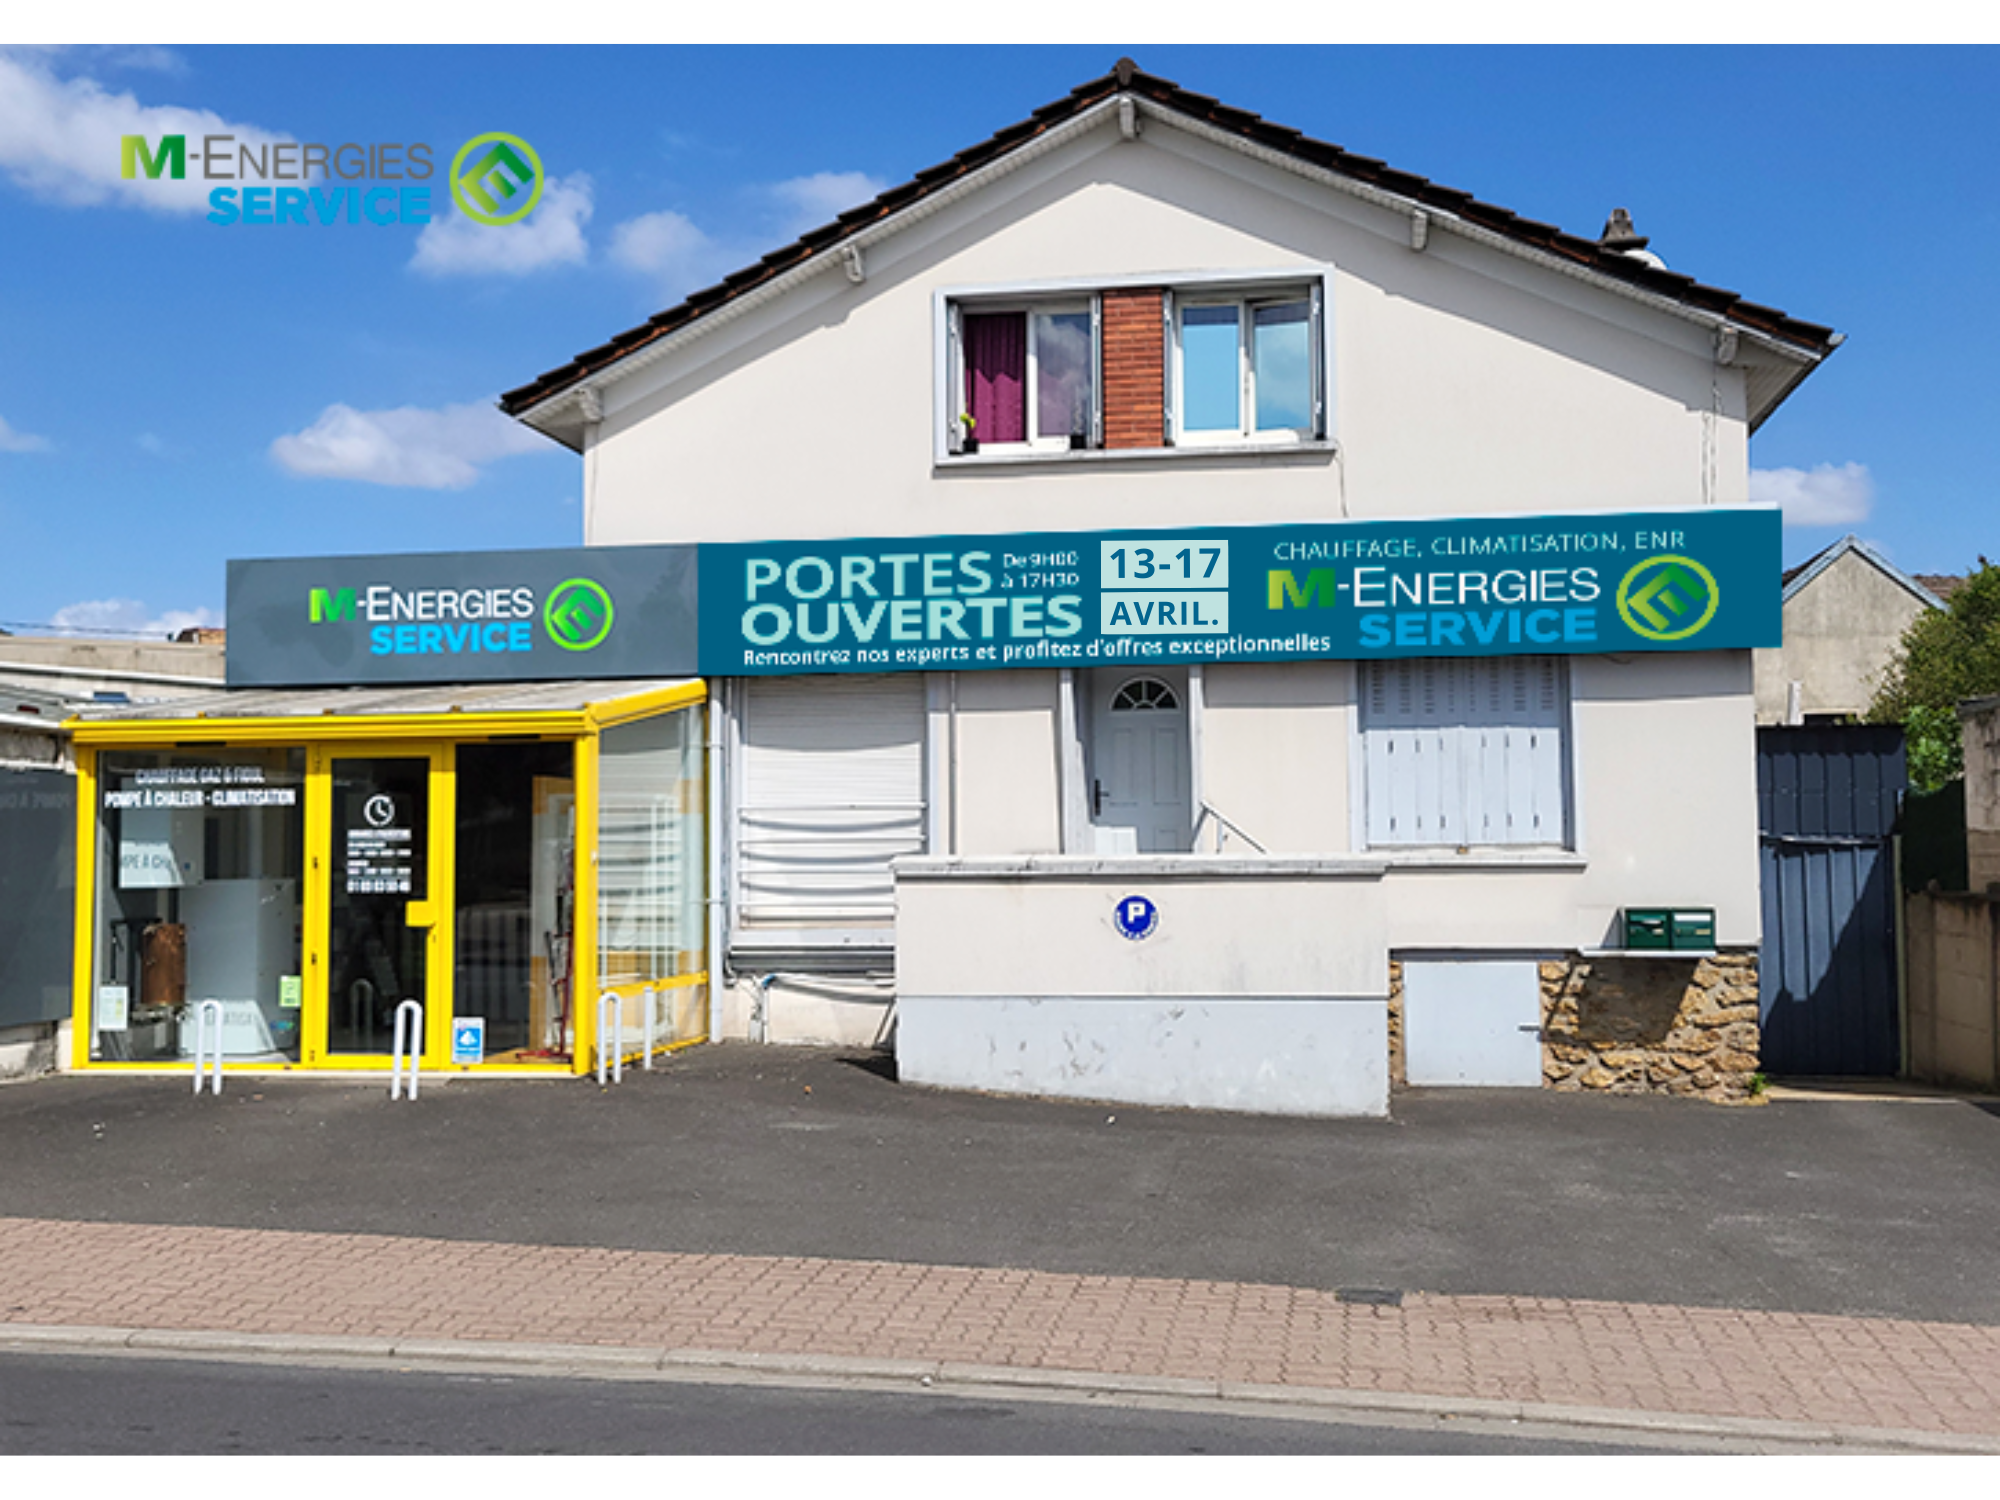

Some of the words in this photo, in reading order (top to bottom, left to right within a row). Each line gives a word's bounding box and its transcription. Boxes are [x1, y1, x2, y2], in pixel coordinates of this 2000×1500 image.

[1274, 538, 1422, 561] CHAUFFAGE,
[1431, 531, 1625, 556] CLIMATISATION,
[1635, 531, 1686, 550] ENR
[745, 551, 992, 601] PORTES
[1017, 572, 1080, 588] 17H30
[1110, 548, 1221, 579] 13-17
[309, 586, 534, 623] M-ENERGIES
[1267, 566, 1601, 610] M-ENERGIES
[741, 595, 1082, 645] OUVERTES
[1110, 601, 1219, 626] AVRIL.
[1358, 607, 1598, 648] SERVICE
[370, 622, 533, 656] SERVICE
[744, 648, 851, 666] Rencontrez
[857, 649, 890, 663] nos
[896, 645, 969, 666] experts
[976, 644, 997, 661] et
[1003, 637, 1082, 663] profitez
[1087, 636, 1163, 658] d'offres
[1169, 633, 1331, 660] exceptionnelles
[1128, 902, 1146, 923] P
